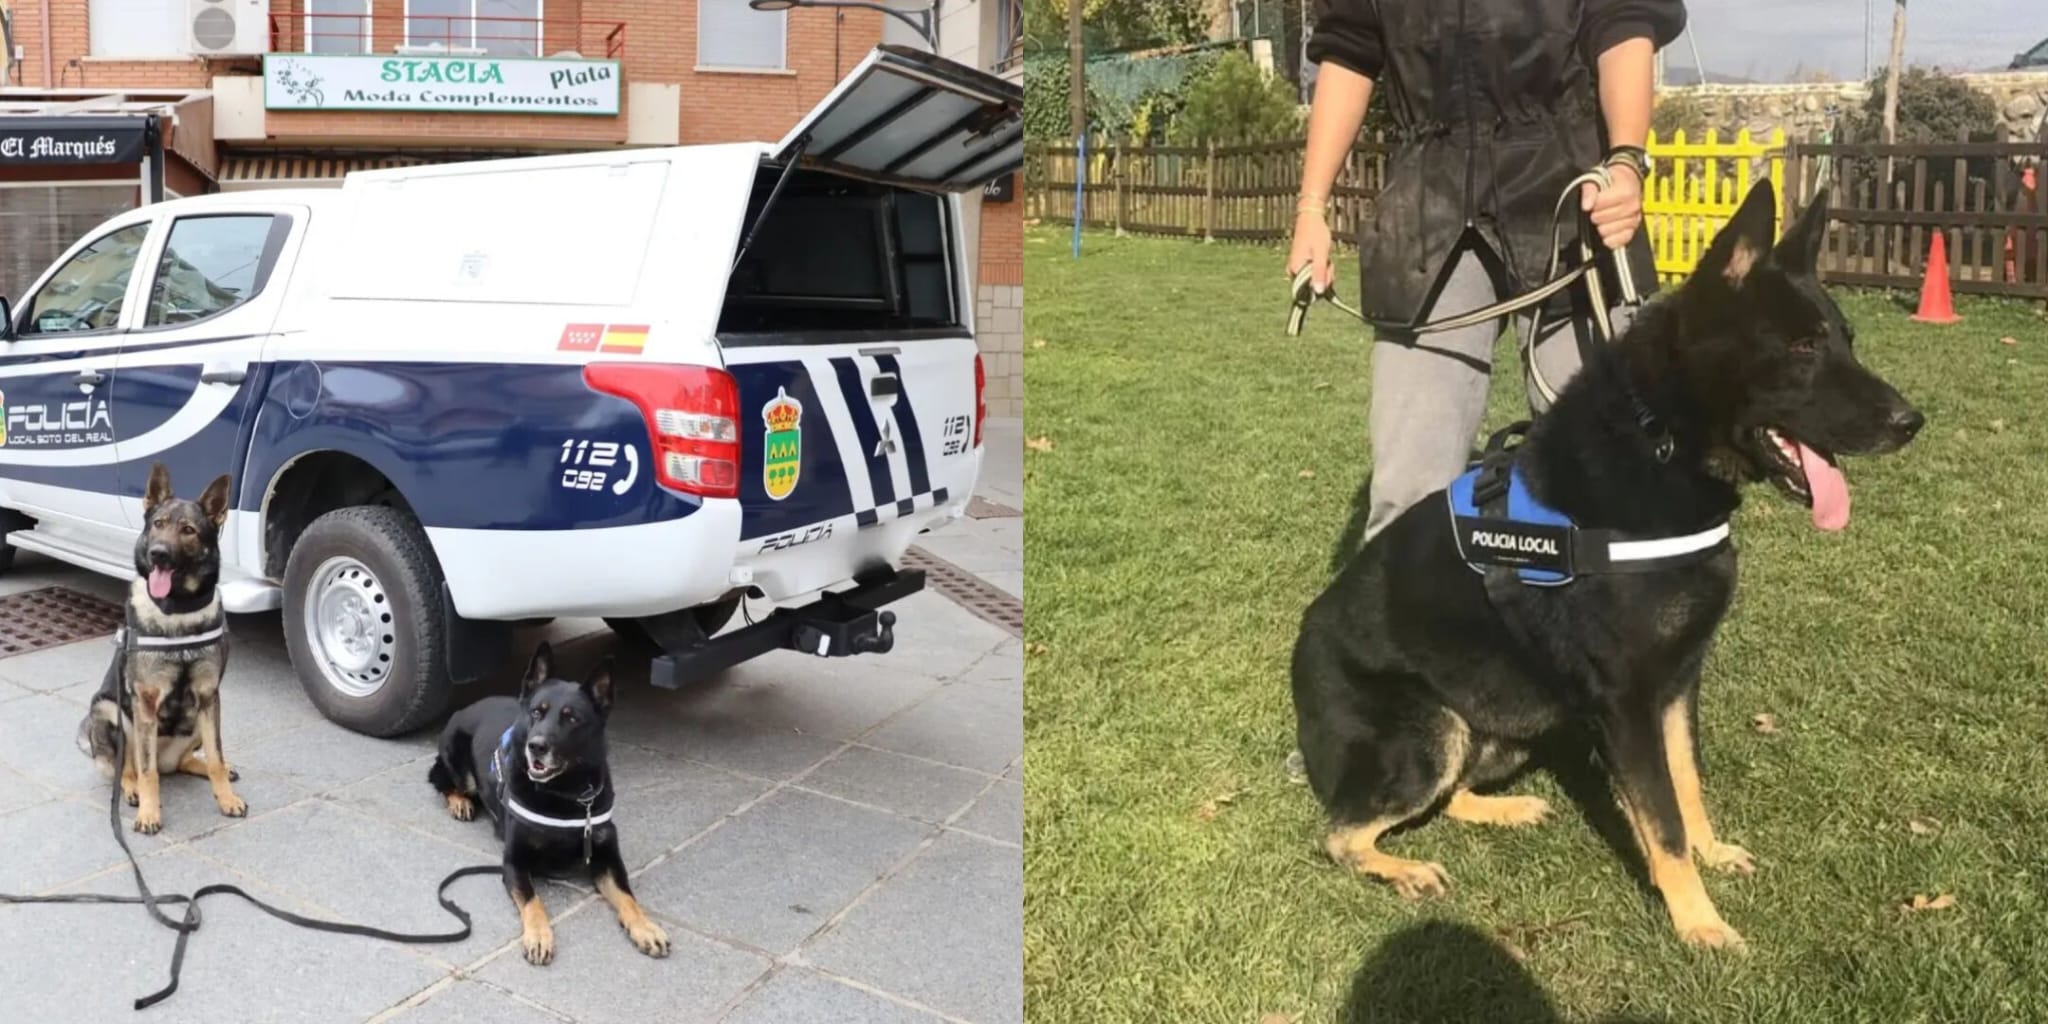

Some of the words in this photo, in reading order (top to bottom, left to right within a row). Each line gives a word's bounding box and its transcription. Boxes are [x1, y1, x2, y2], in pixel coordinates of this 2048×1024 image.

[380, 60, 504, 84] STACIA
[549, 65, 612, 90] Plata
[344, 89, 411, 103] Moda
[419, 90, 598, 107] Complementos
[0, 137, 24, 157] El
[29, 135, 116, 159] Marqués
[8, 436, 35, 444] LOCAL
[37, 434, 62, 444] SOTO
[64, 433, 84, 443] DEL
[86, 432, 112, 442] REAL
[944, 415, 965, 437] 112
[560, 439, 619, 467] 112
[562, 469, 607, 491] 092
[1472, 531, 1517, 550] POLICIA
[1519, 536, 1559, 555] LOCAL
